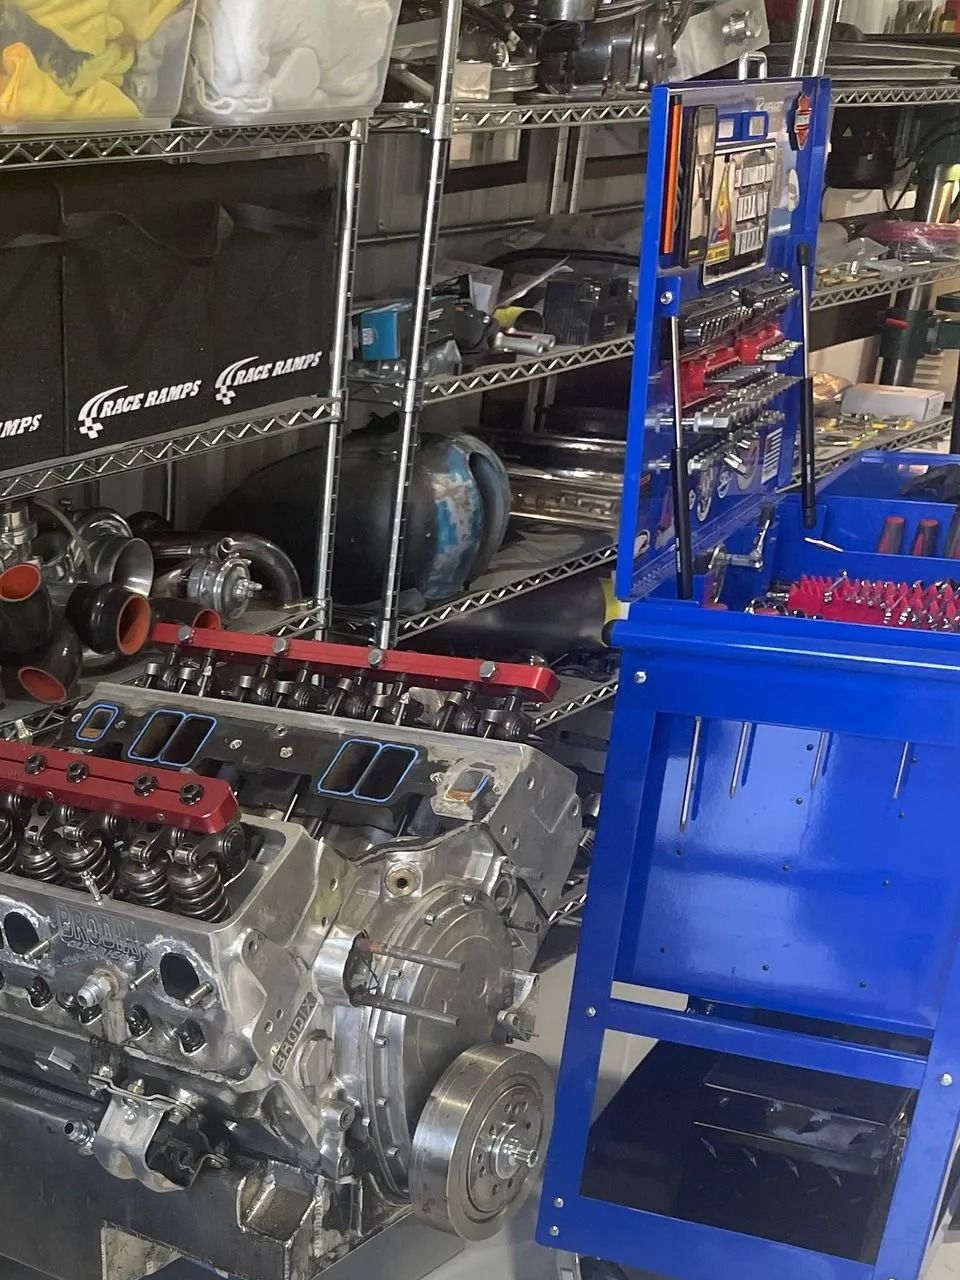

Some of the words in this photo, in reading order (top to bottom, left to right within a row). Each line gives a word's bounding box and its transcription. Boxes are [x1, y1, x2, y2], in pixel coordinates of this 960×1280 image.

[233, 367, 271, 387] RACE
[271, 352, 323, 378] RAMPS
[100, 393, 144, 418] RACE
[144, 380, 202, 408] RAMPS
[273, 997, 315, 1071] BRODIX
